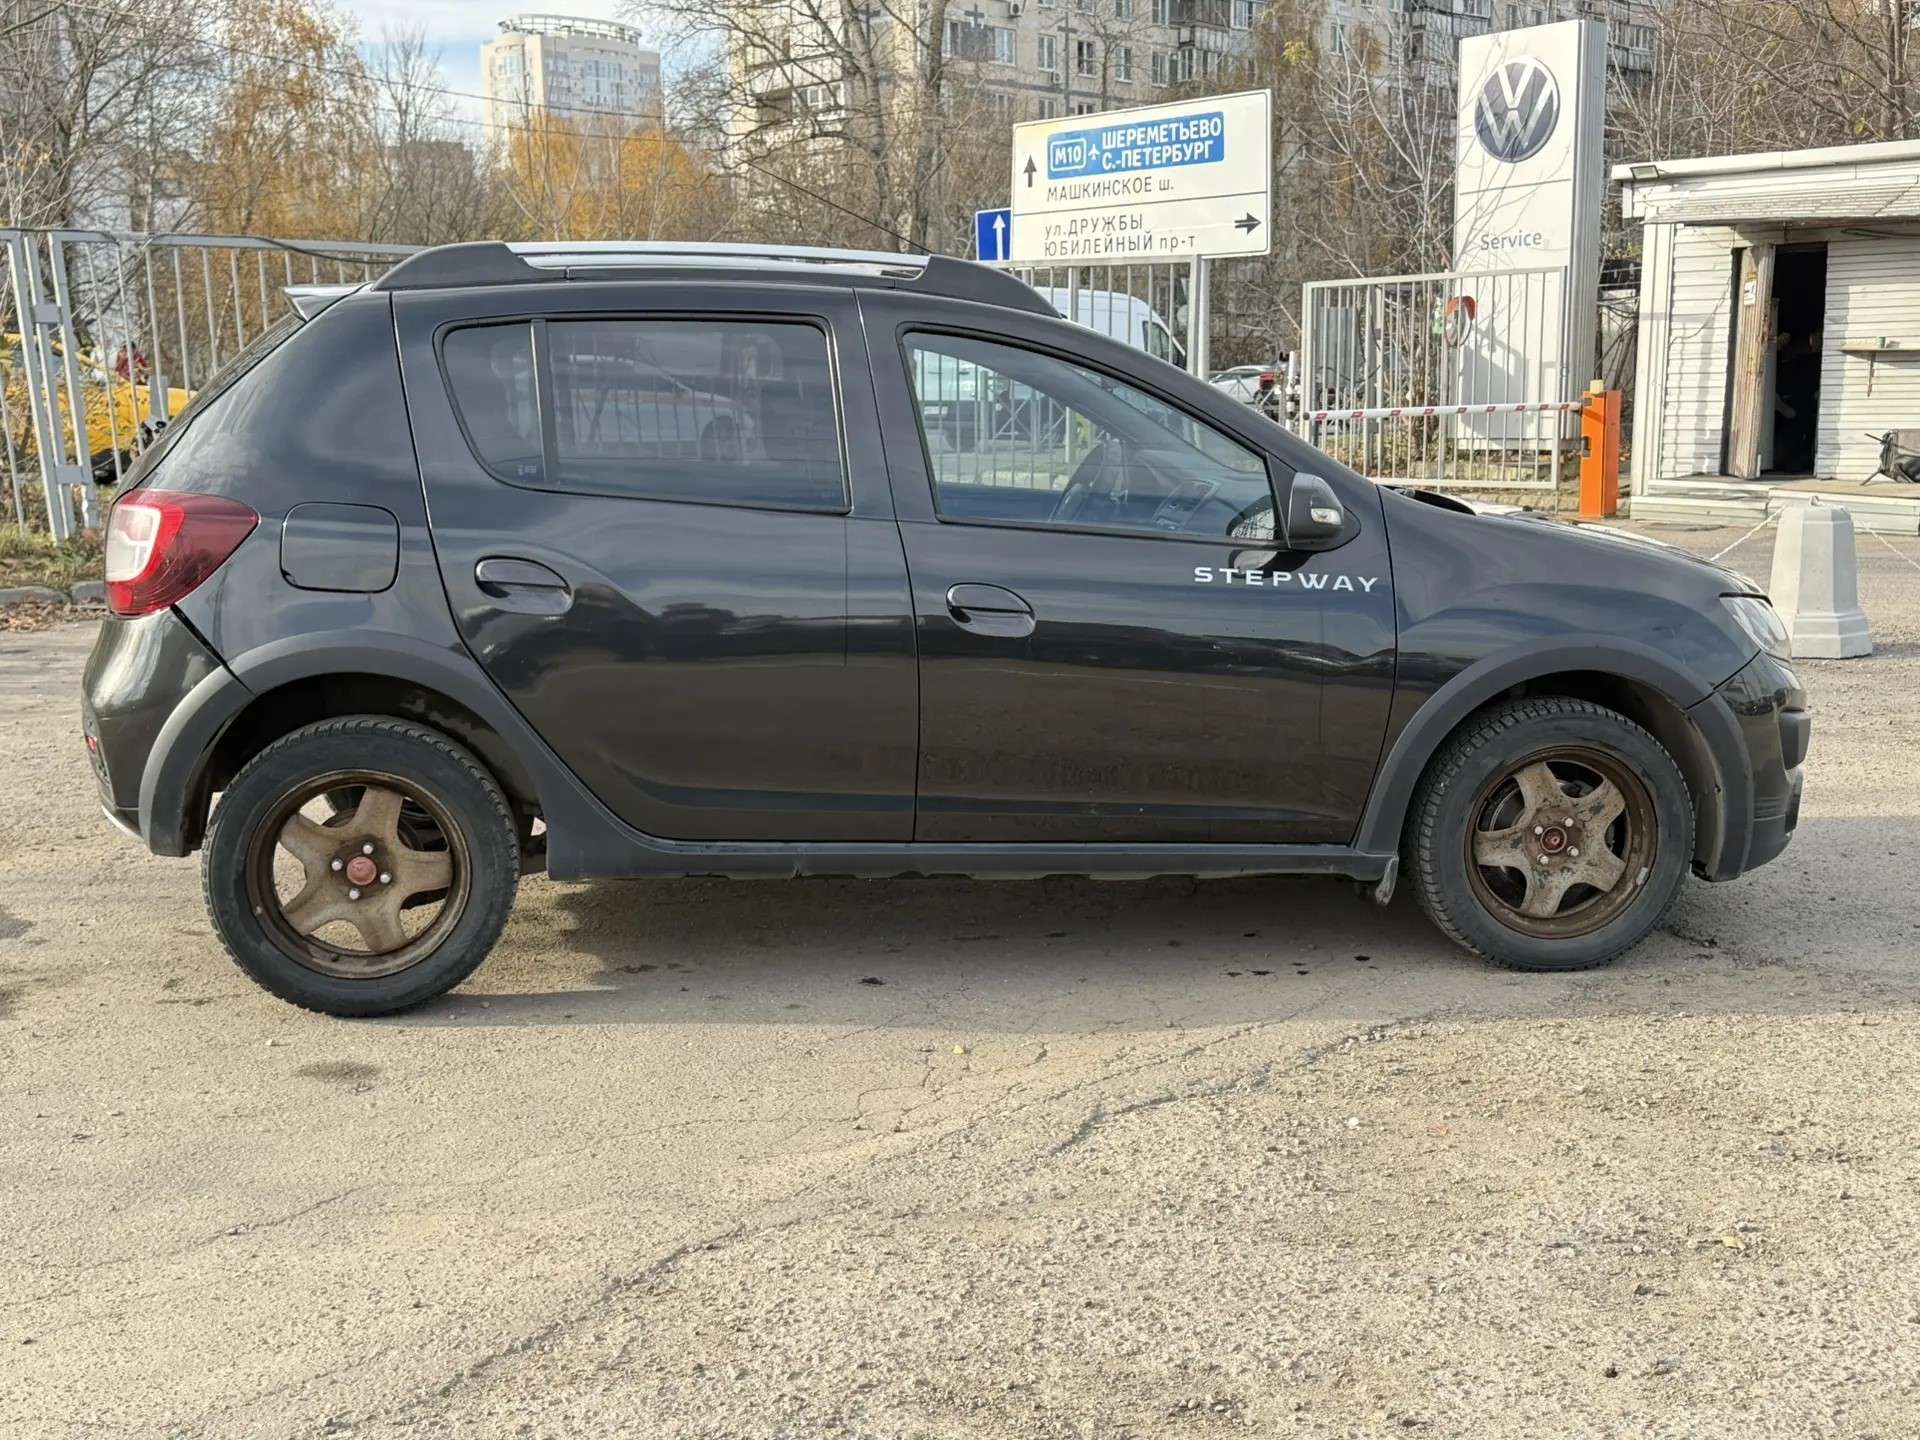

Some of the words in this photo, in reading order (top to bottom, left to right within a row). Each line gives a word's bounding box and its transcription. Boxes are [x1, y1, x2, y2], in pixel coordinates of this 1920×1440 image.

[1102, 117, 1222, 149] ШЕРЕМЕТЬЕВО
[1102, 140, 1214, 170] С.-ПЕТЕРБУРГ
[1046, 176, 1152, 201] МАШКИНСКОЕ
[1158, 180, 1175, 191] ш.
[1043, 230, 1153, 257] ЮБИЛЕЙНЫЙ
[1159, 236, 1196, 253] пр-т
[1480, 229, 1543, 251] Service
[1194, 566, 1379, 592] STEPWAY
